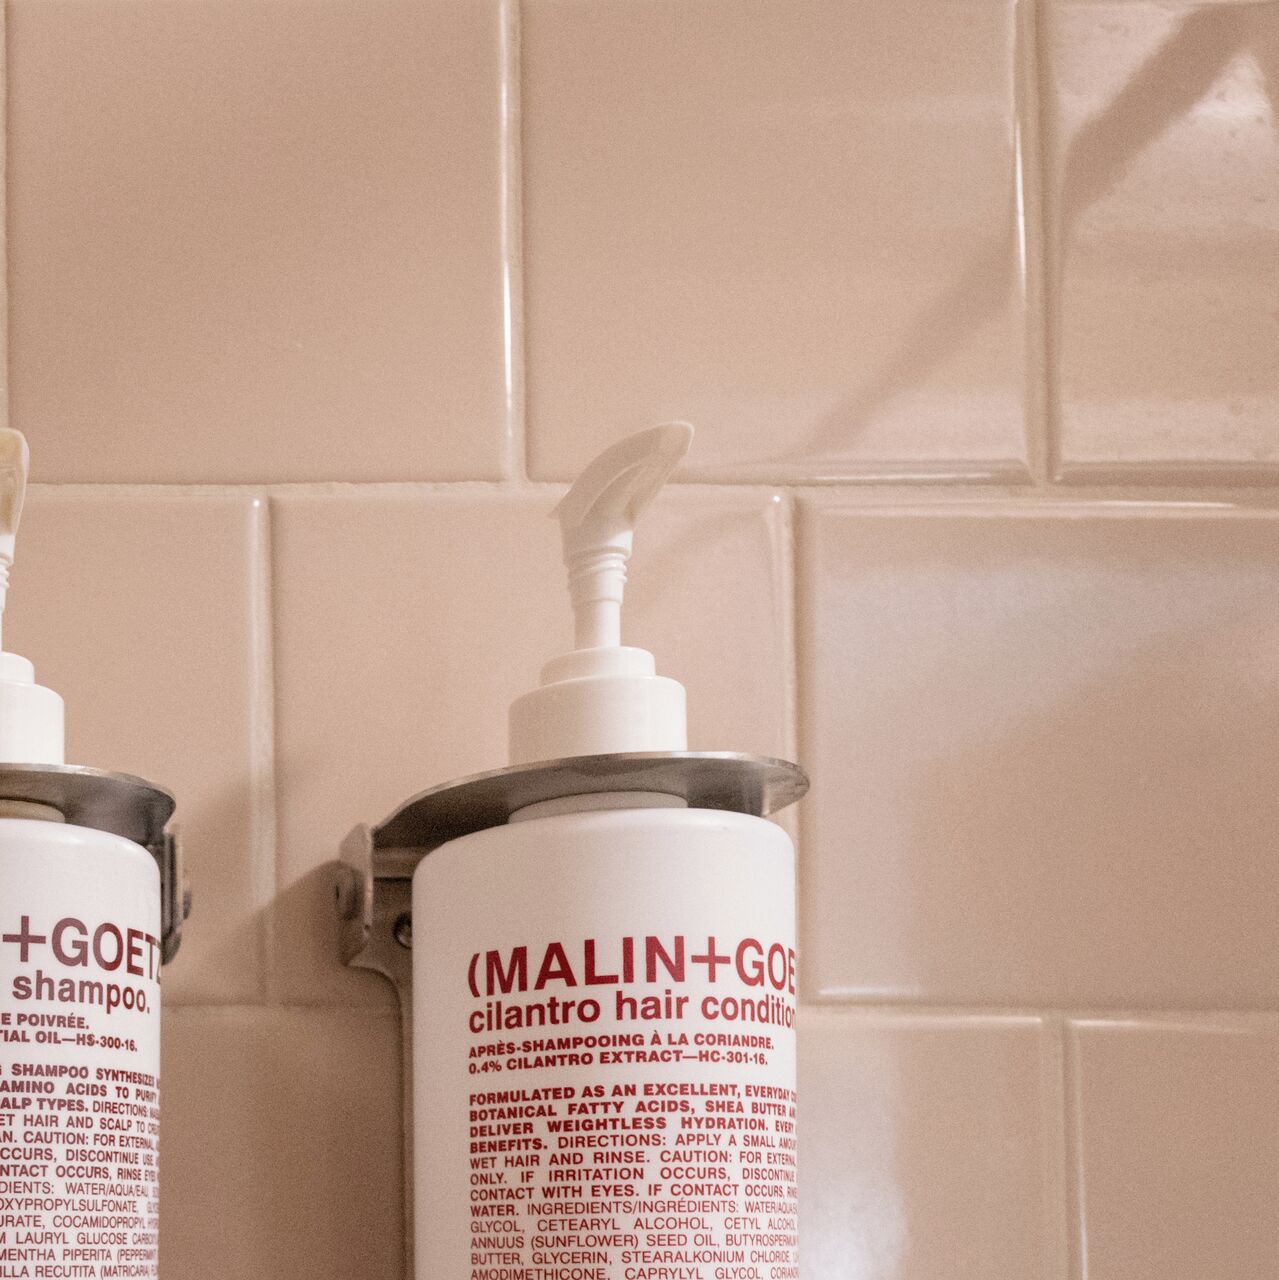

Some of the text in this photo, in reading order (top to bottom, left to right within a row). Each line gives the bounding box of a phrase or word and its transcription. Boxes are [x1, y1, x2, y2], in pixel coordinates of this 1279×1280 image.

[12, 969, 151, 1015] shampoo.
[468, 994, 601, 1033] cilantro
[616, 989, 689, 1021] hair
[17, 1012, 89, 1030] POIVRÉE.
[468, 1030, 774, 1059] APRÈS-SHAMPOOING À LA CORIANDRE.
[11, 1063, 89, 1079] SHAMPOO
[469, 1060, 502, 1075] 0.4%
[506, 1052, 593, 1070] CILANTRO
[0, 1080, 55, 1094] AMINO
[66, 1082, 107, 1097] ACIDS
[115, 1086, 129, 1099] TO
[469, 1087, 575, 1106] FORMULATED
[581, 1085, 605, 1098] AS
[611, 1084, 636, 1097] AN
[643, 1083, 740, 1099] EXCELLENT,
[745, 1085, 790, 1100] EVERYDAY
[36, 1098, 89, 1112] TYPES.
[470, 1100, 786, 1122] BOTANICAL FATTY ACIDS, SHEA BUTTER
[470, 1117, 768, 1138] DELIVER WEIGHTLESS HYDRATION.
[23, 1131, 89, 1145] CAUTION:
[93, 1133, 116, 1146] FOR
[470, 1133, 776, 1154] BENEFITS. DIRECTIONS: APPLY SMALL
[470, 1167, 730, 1186] ONLY. IRRITATION OCCURS,
[470, 1196, 739, 1217] WATER. INGREDIENTS/INGRÉDIENTS:
[537, 1217, 761, 1232] CETEARYL ALCOHOL, CETYL
[16, 1231, 69, 1245] LAURYL
[531, 1233, 720, 1251] (SUNFLOWER) SEED OIL,
[532, 1250, 744, 1265] GLYCERIN, STEARALKONIUM
[35, 1265, 96, 1278] RECUTITA
